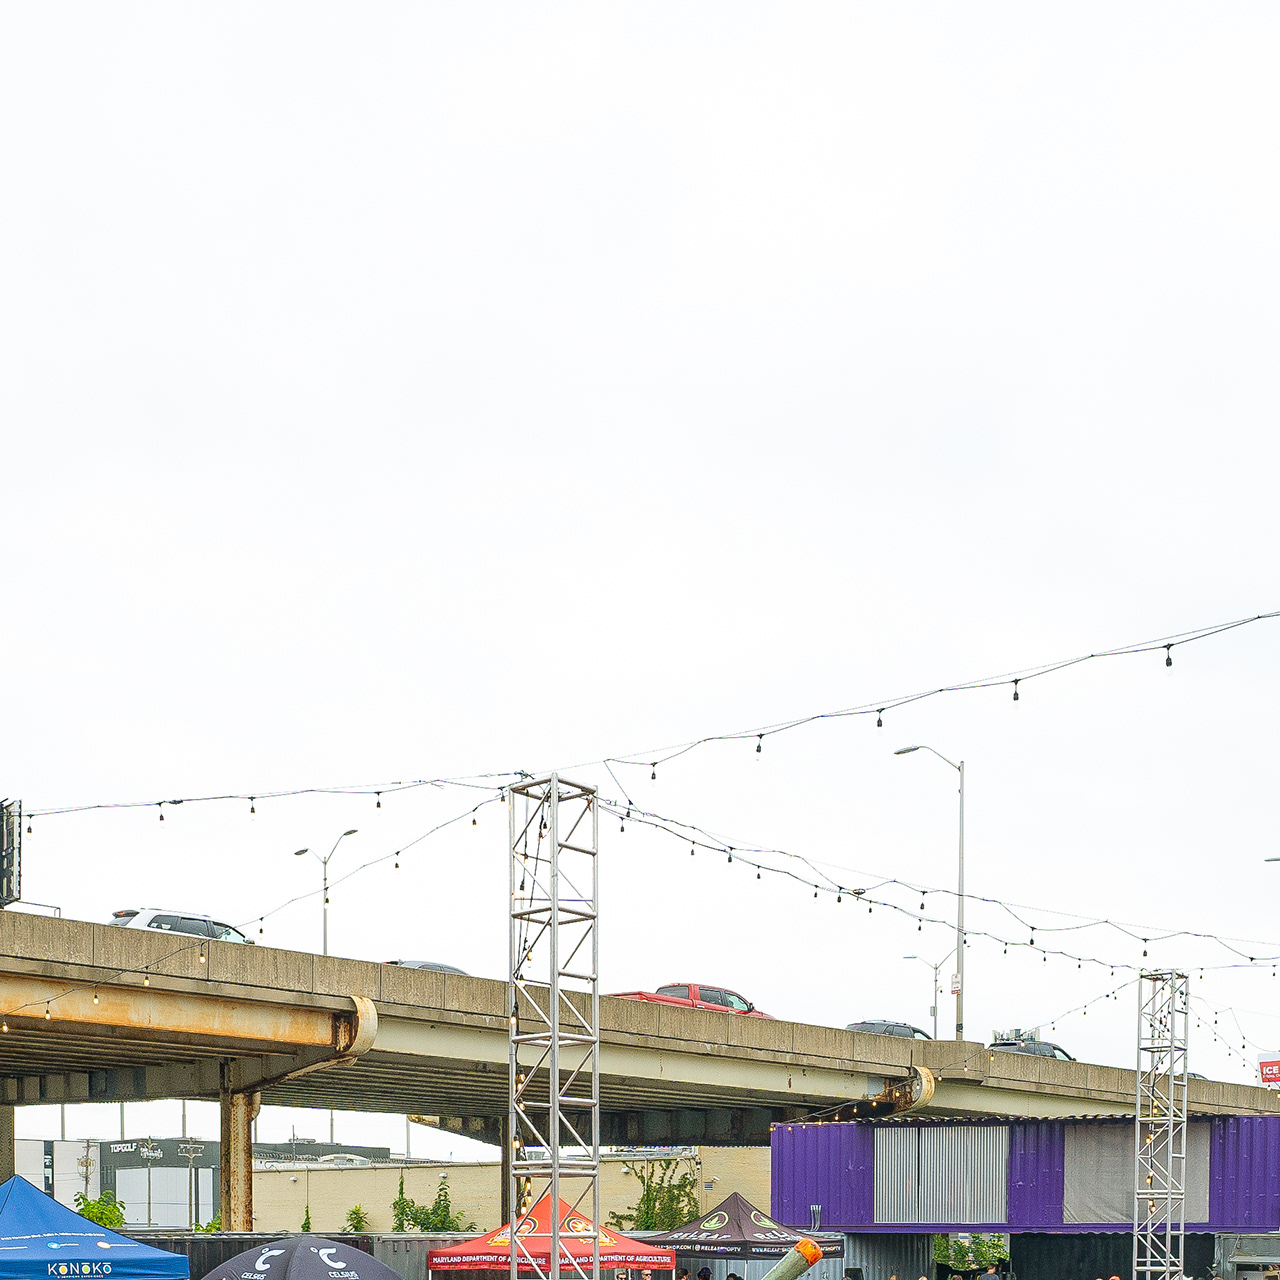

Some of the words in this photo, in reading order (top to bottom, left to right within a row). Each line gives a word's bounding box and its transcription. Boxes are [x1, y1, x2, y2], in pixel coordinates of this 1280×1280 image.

[1263, 1066, 1280, 1074] ICE
[110, 1142, 137, 1153] TOPGOLF
[668, 1230, 732, 1241] RELEAF
[635, 1255, 671, 1263] AGRICULTURE
